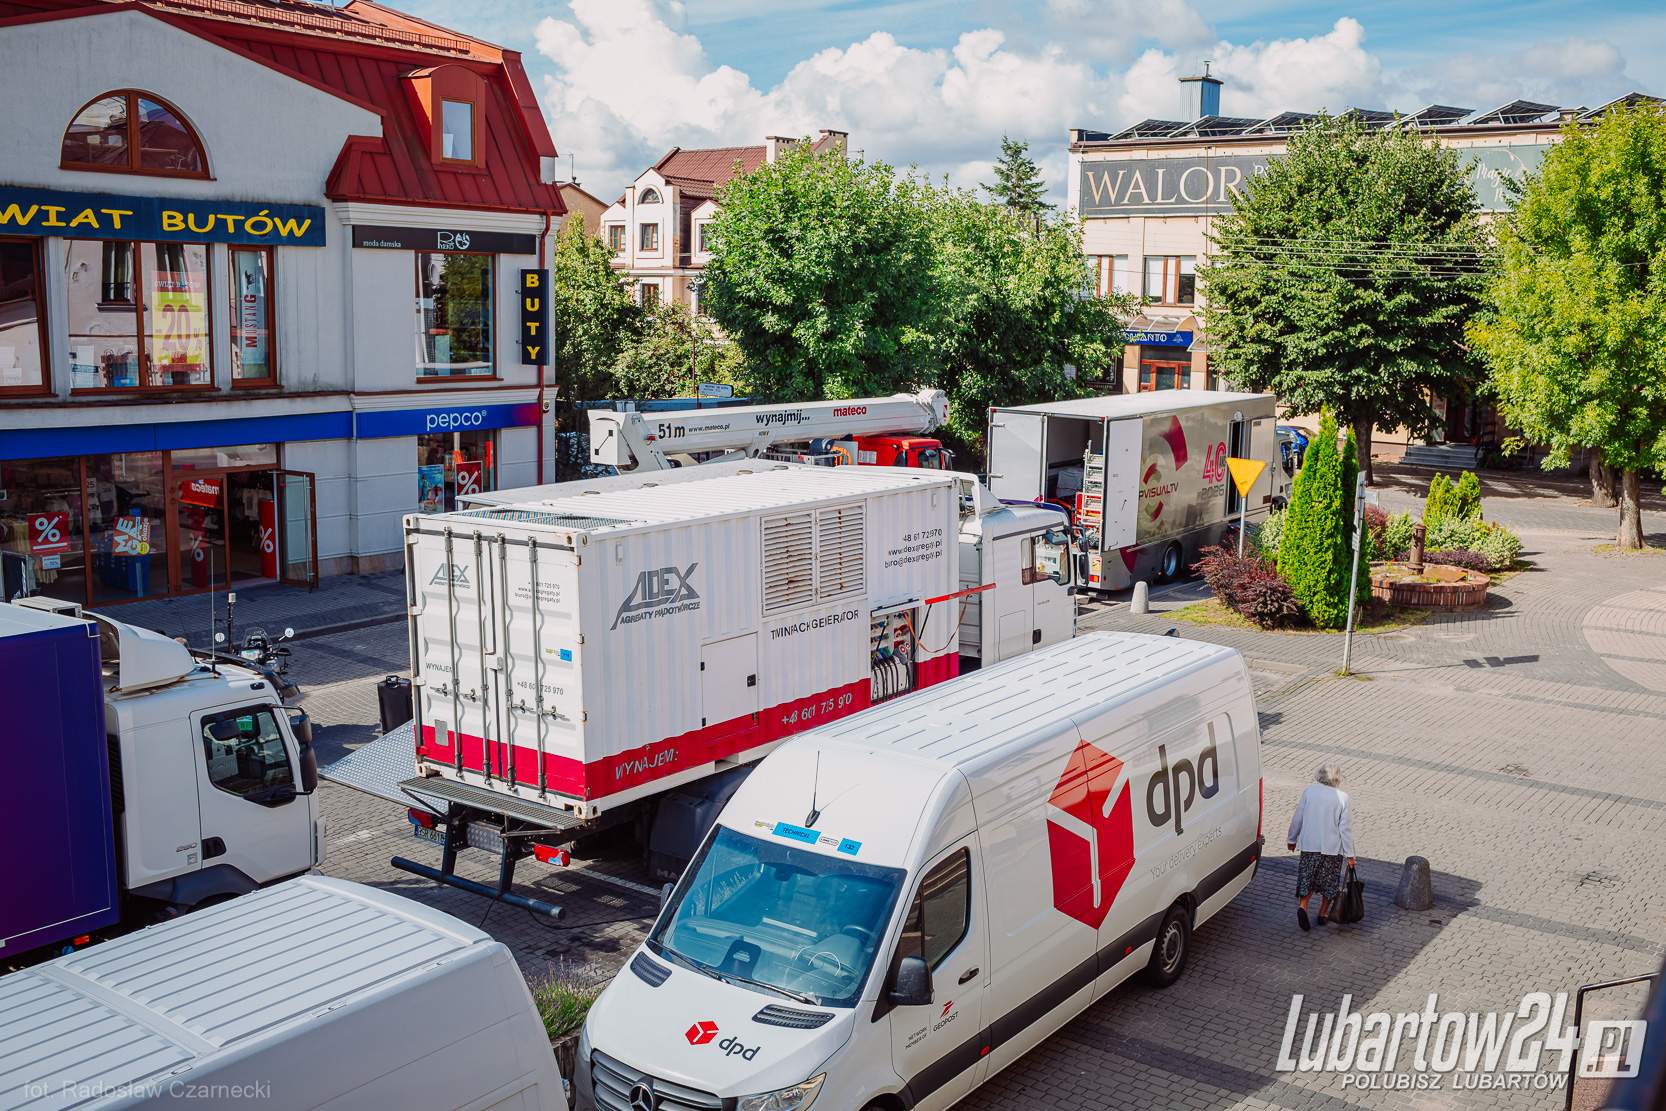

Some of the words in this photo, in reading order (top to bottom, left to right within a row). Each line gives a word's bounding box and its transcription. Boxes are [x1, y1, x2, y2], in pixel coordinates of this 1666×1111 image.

[1086, 165, 1244, 205] WALOR
[162, 208, 311, 237] BUTÓW
[363, 239, 379, 247] moda
[380, 239, 401, 248] damska
[244, 294, 257, 348] MUSTANG
[526, 273, 541, 360] BUTY
[688, 423, 730, 433] www.mateco.pl
[832, 405, 867, 417] mateco
[811, 609, 859, 629] GEERATOR
[1146, 721, 1220, 836] dpd
[933, 1011, 959, 1032] GEOPOST
[718, 1035, 761, 1062] dpd
